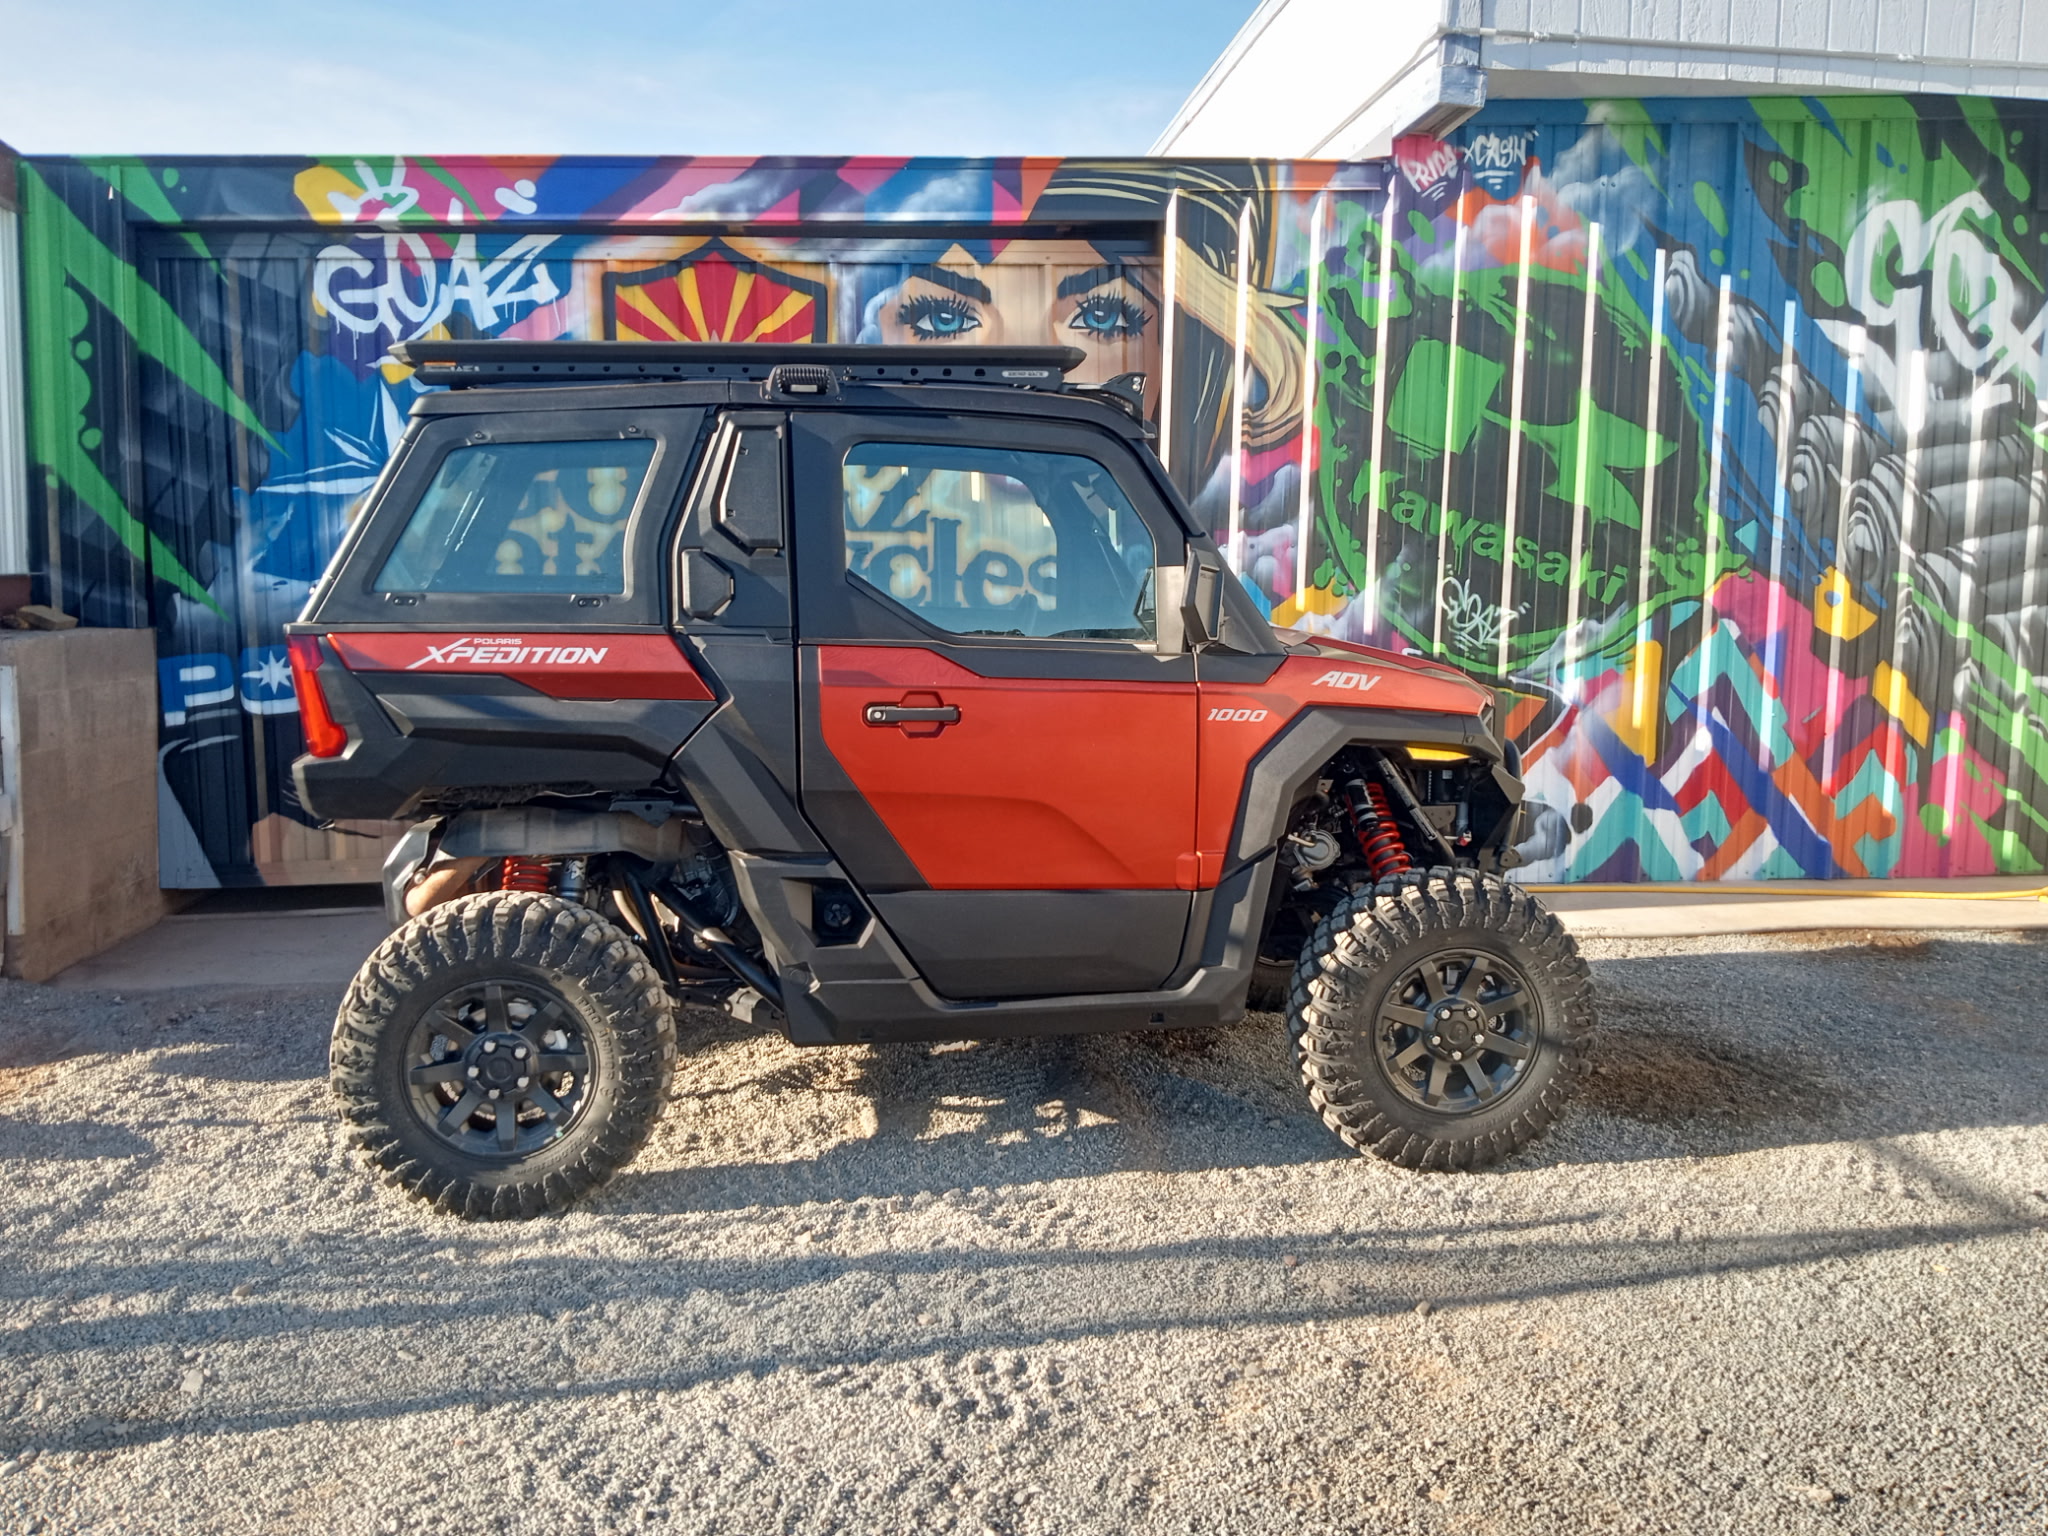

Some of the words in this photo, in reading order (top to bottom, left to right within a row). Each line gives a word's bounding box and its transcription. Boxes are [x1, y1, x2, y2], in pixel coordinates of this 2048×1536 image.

[1351, 459, 1629, 606] Kawasaki
[405, 637, 609, 670] XPEDITION
[1311, 670, 1382, 691] ADV
[1207, 708, 1268, 723] 1000
